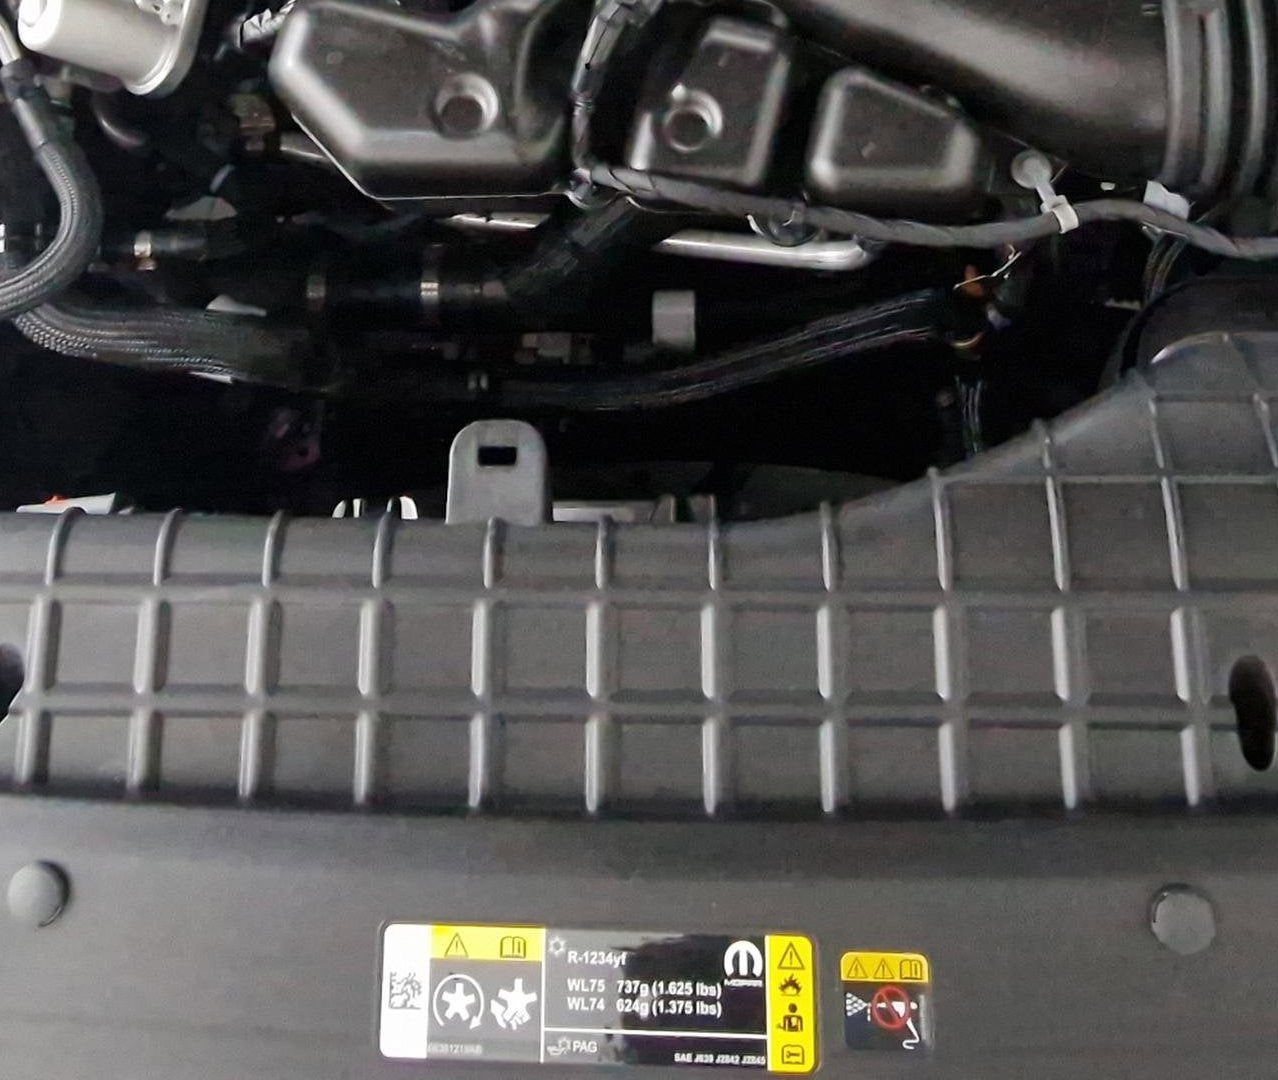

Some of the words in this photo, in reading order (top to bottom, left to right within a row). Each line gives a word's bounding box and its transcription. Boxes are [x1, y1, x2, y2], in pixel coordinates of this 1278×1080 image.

[567, 951, 628, 968] R-1234yf
[567, 979, 606, 993] WL75
[617, 980, 650, 997] 737g
[652, 980, 693, 996] (1.625
[696, 982, 722, 999] lbs)
[567, 997, 606, 1011] WL74
[616, 998, 650, 1015] 624g
[652, 999, 693, 1015] (1.375
[696, 1001, 722, 1019] lbs)
[572, 1040, 598, 1053] PAG
[674, 1053, 693, 1063] SAE
